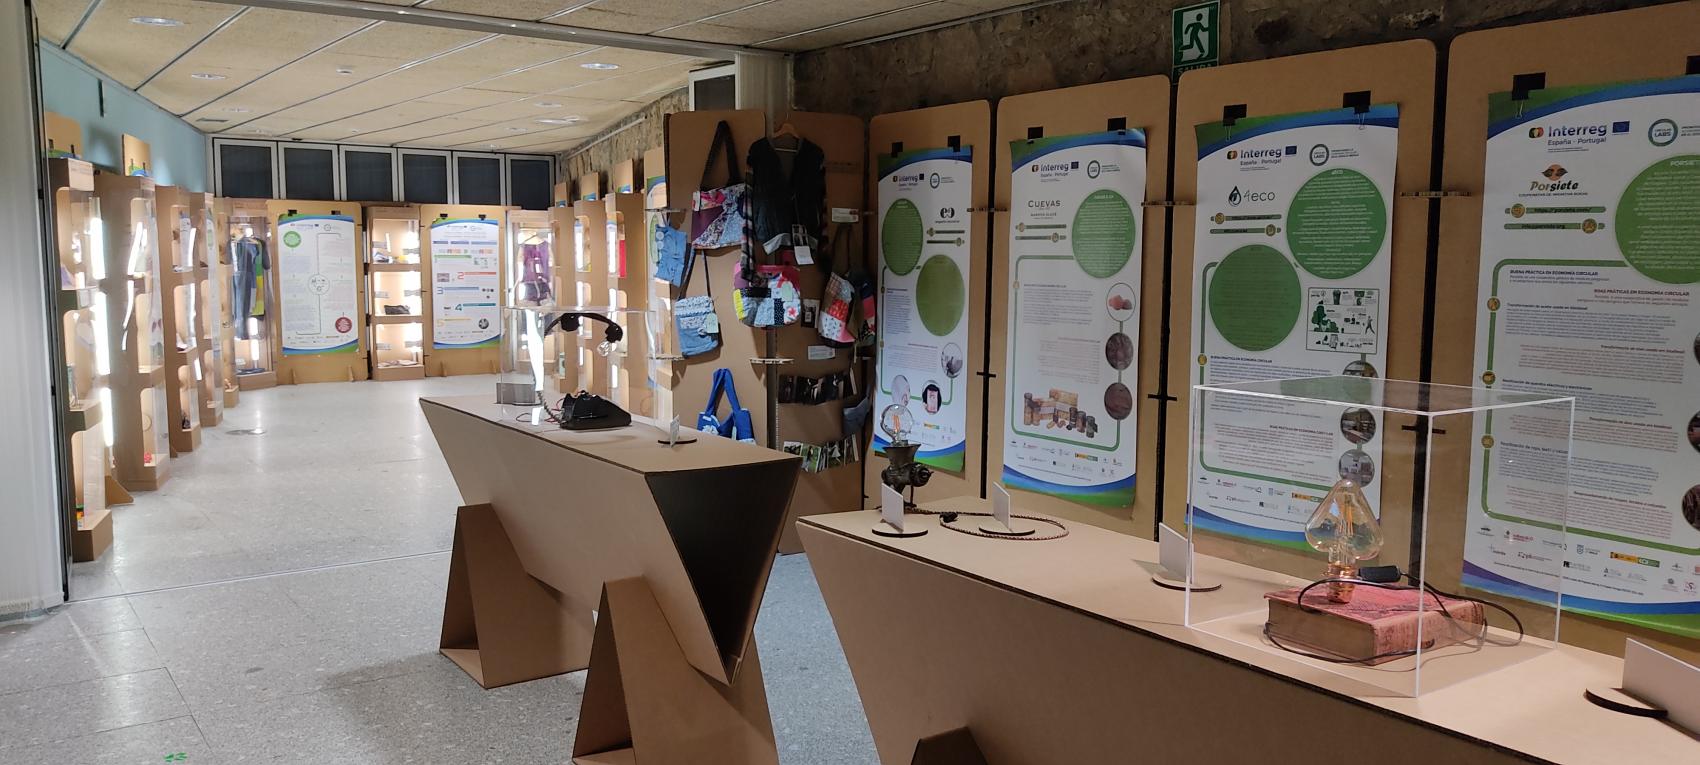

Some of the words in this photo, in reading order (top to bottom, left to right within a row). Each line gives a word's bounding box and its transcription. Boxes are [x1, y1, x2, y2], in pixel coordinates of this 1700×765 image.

[1548, 124, 1607, 138] Interreg
[1547, 139, 1572, 147] España
[1577, 137, 1607, 145] Portugal
[1240, 148, 1282, 160] Interreg
[1040, 163, 1069, 172] Interreg
[1530, 180, 1579, 192] Porsiete
[1243, 190, 1276, 203] 4eco
[1028, 200, 1061, 208] CUEVAS
